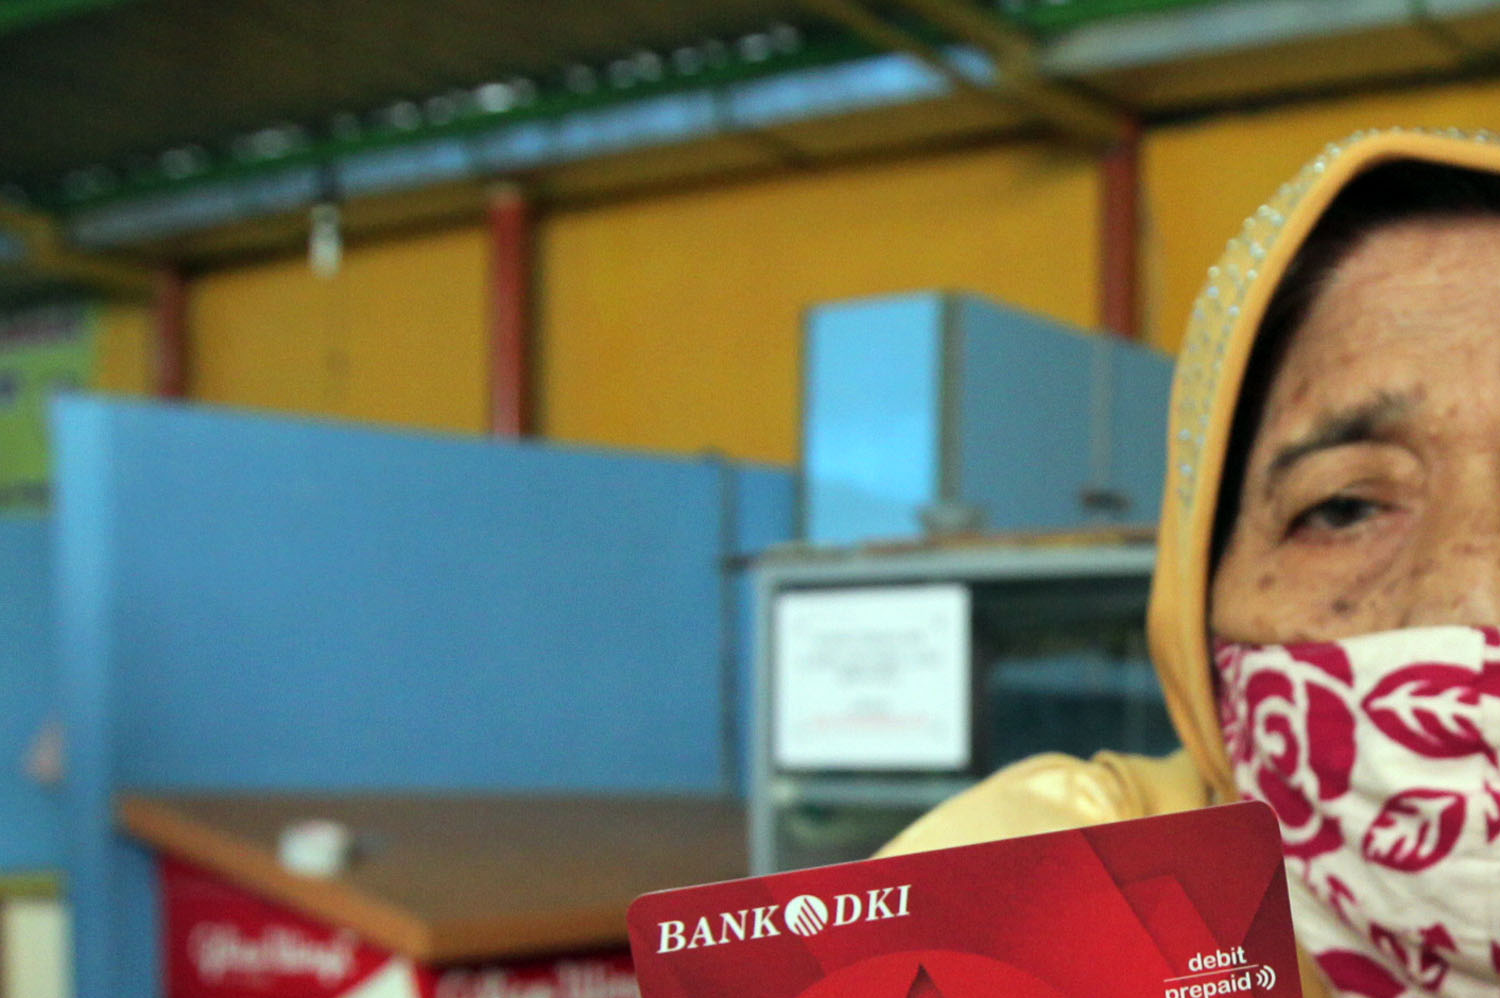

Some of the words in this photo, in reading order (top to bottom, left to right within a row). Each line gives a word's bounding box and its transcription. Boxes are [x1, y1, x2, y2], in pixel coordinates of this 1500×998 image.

[656, 904, 781, 954] BANK
[832, 884, 912, 927] DKI
[1188, 946, 1248, 972] debit
